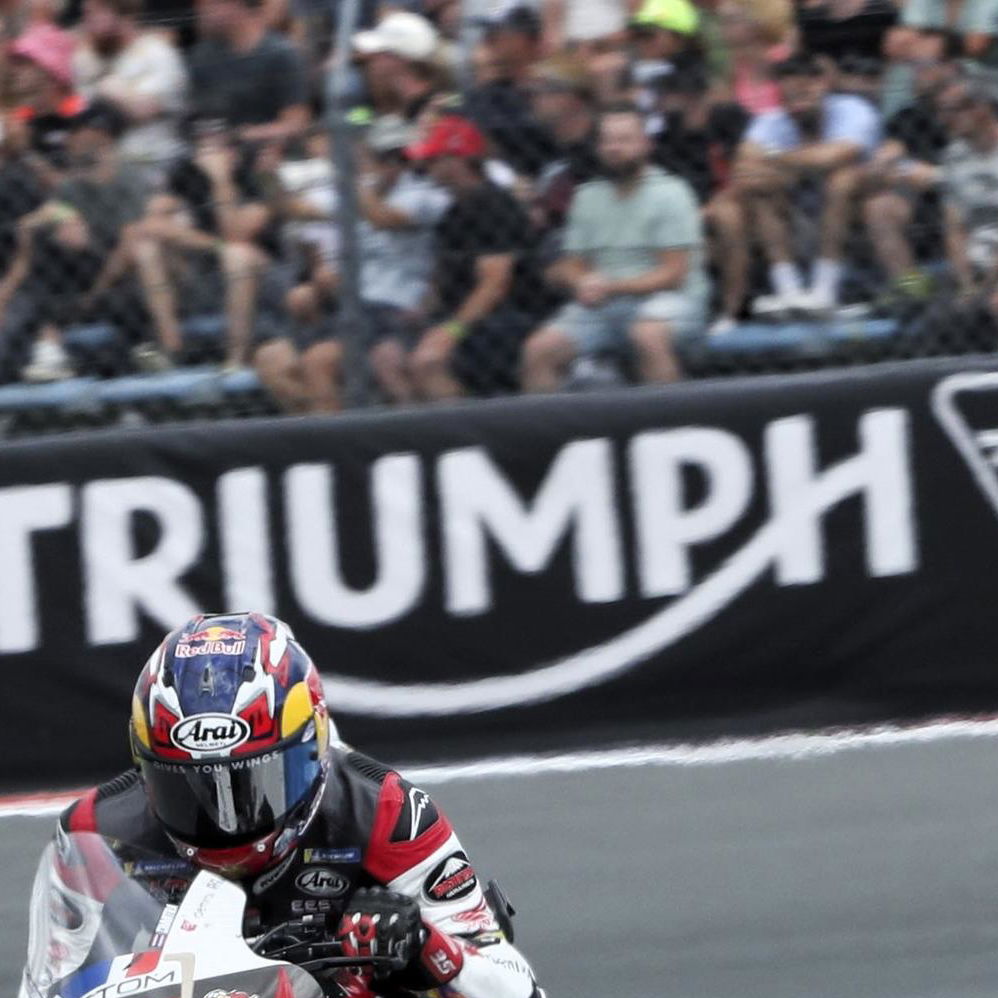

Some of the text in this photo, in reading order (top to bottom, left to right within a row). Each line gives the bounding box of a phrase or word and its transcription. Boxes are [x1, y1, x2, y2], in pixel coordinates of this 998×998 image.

[0, 408, 917, 655] TRIUMPH
[175, 640, 246, 659] Red Bull
[178, 720, 237, 744] Arai
[153, 750, 281, 774] GIVES YOU WINGS
[301, 871, 342, 889] Arai
[430, 949, 456, 975] 35
